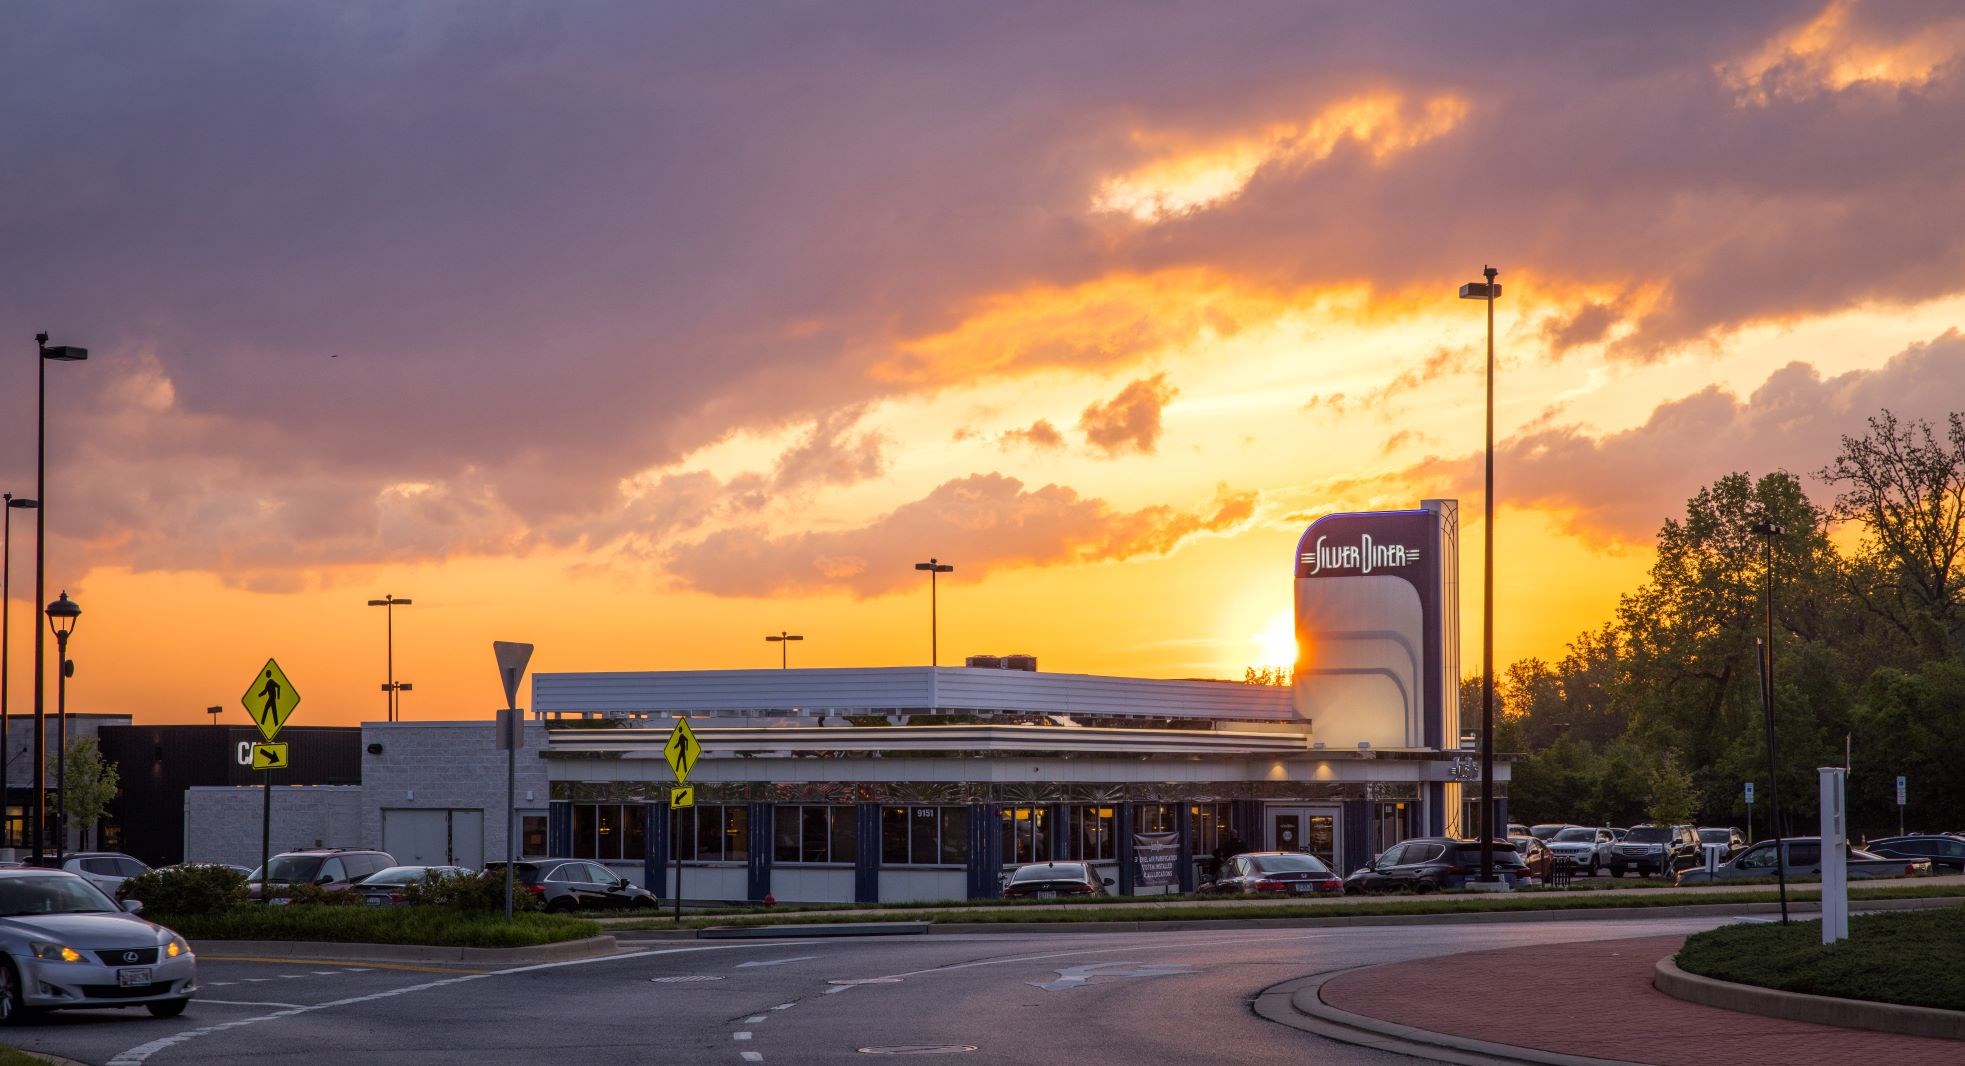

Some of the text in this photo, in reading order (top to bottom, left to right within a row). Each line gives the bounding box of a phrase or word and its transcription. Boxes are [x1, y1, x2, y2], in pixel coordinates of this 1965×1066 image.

[1310, 533, 1406, 575] SILVER DINER
[917, 809, 934, 817] 9151
